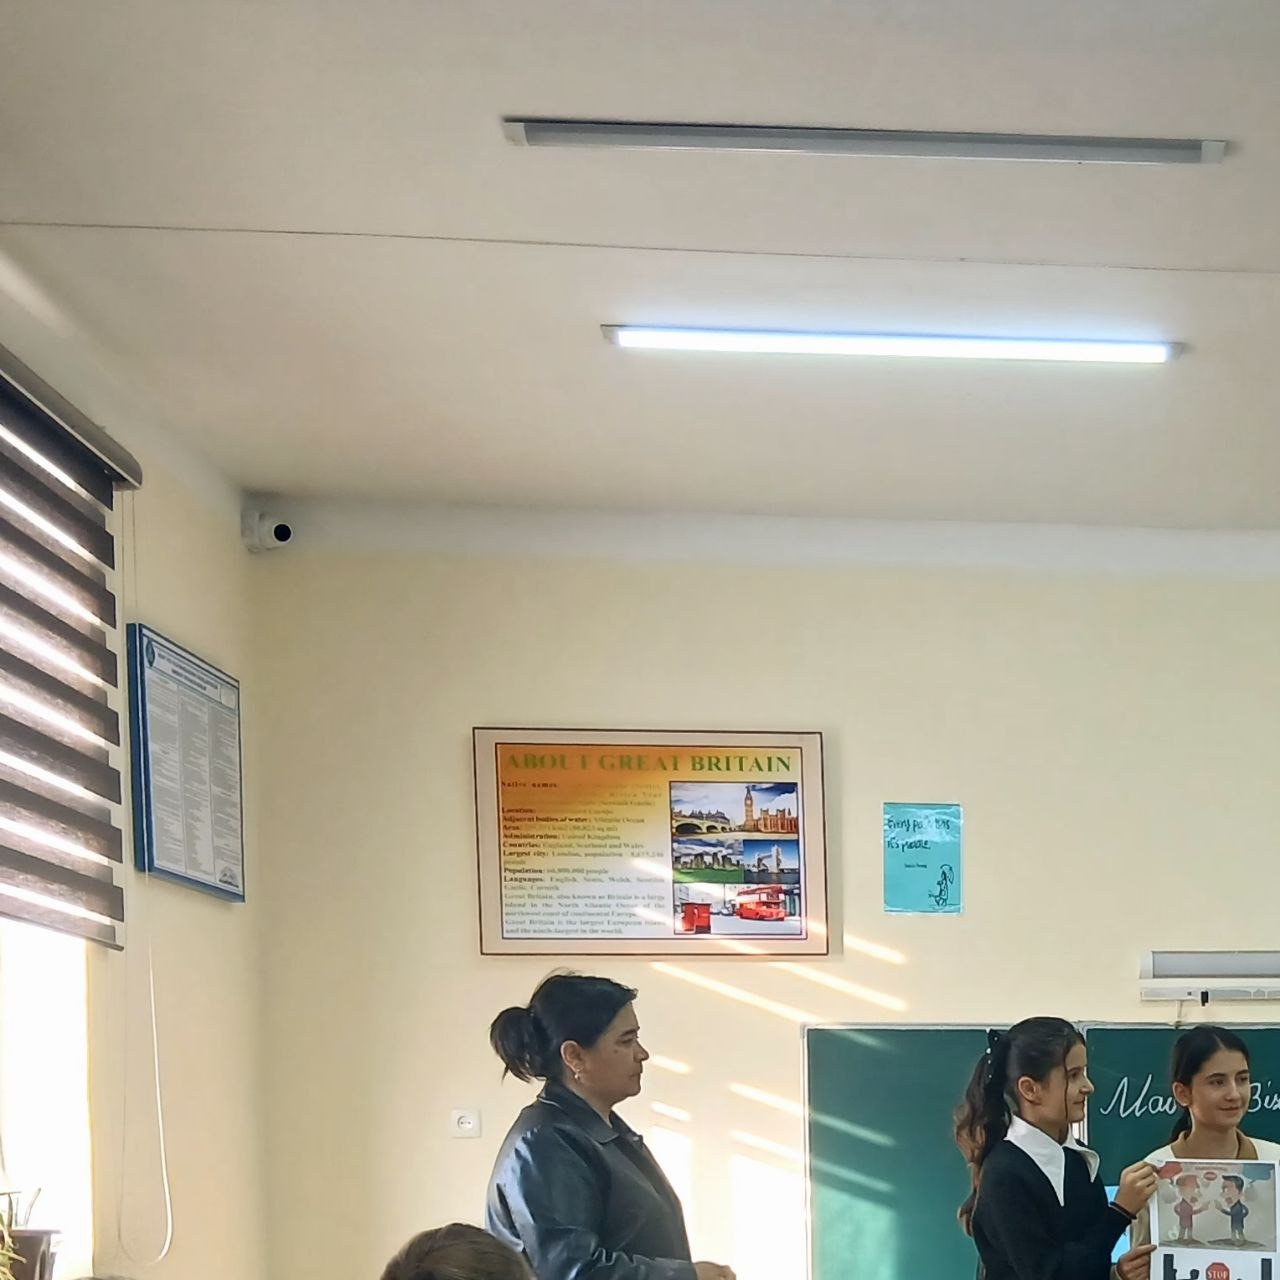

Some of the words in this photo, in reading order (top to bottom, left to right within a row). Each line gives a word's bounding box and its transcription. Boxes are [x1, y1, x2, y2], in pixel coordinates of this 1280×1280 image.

[507, 753, 588, 770] ABOUT
[599, 754, 681, 771] GREAT
[691, 755, 791, 773] BRITAIN
[1207, 1268, 1228, 1280] STOP
